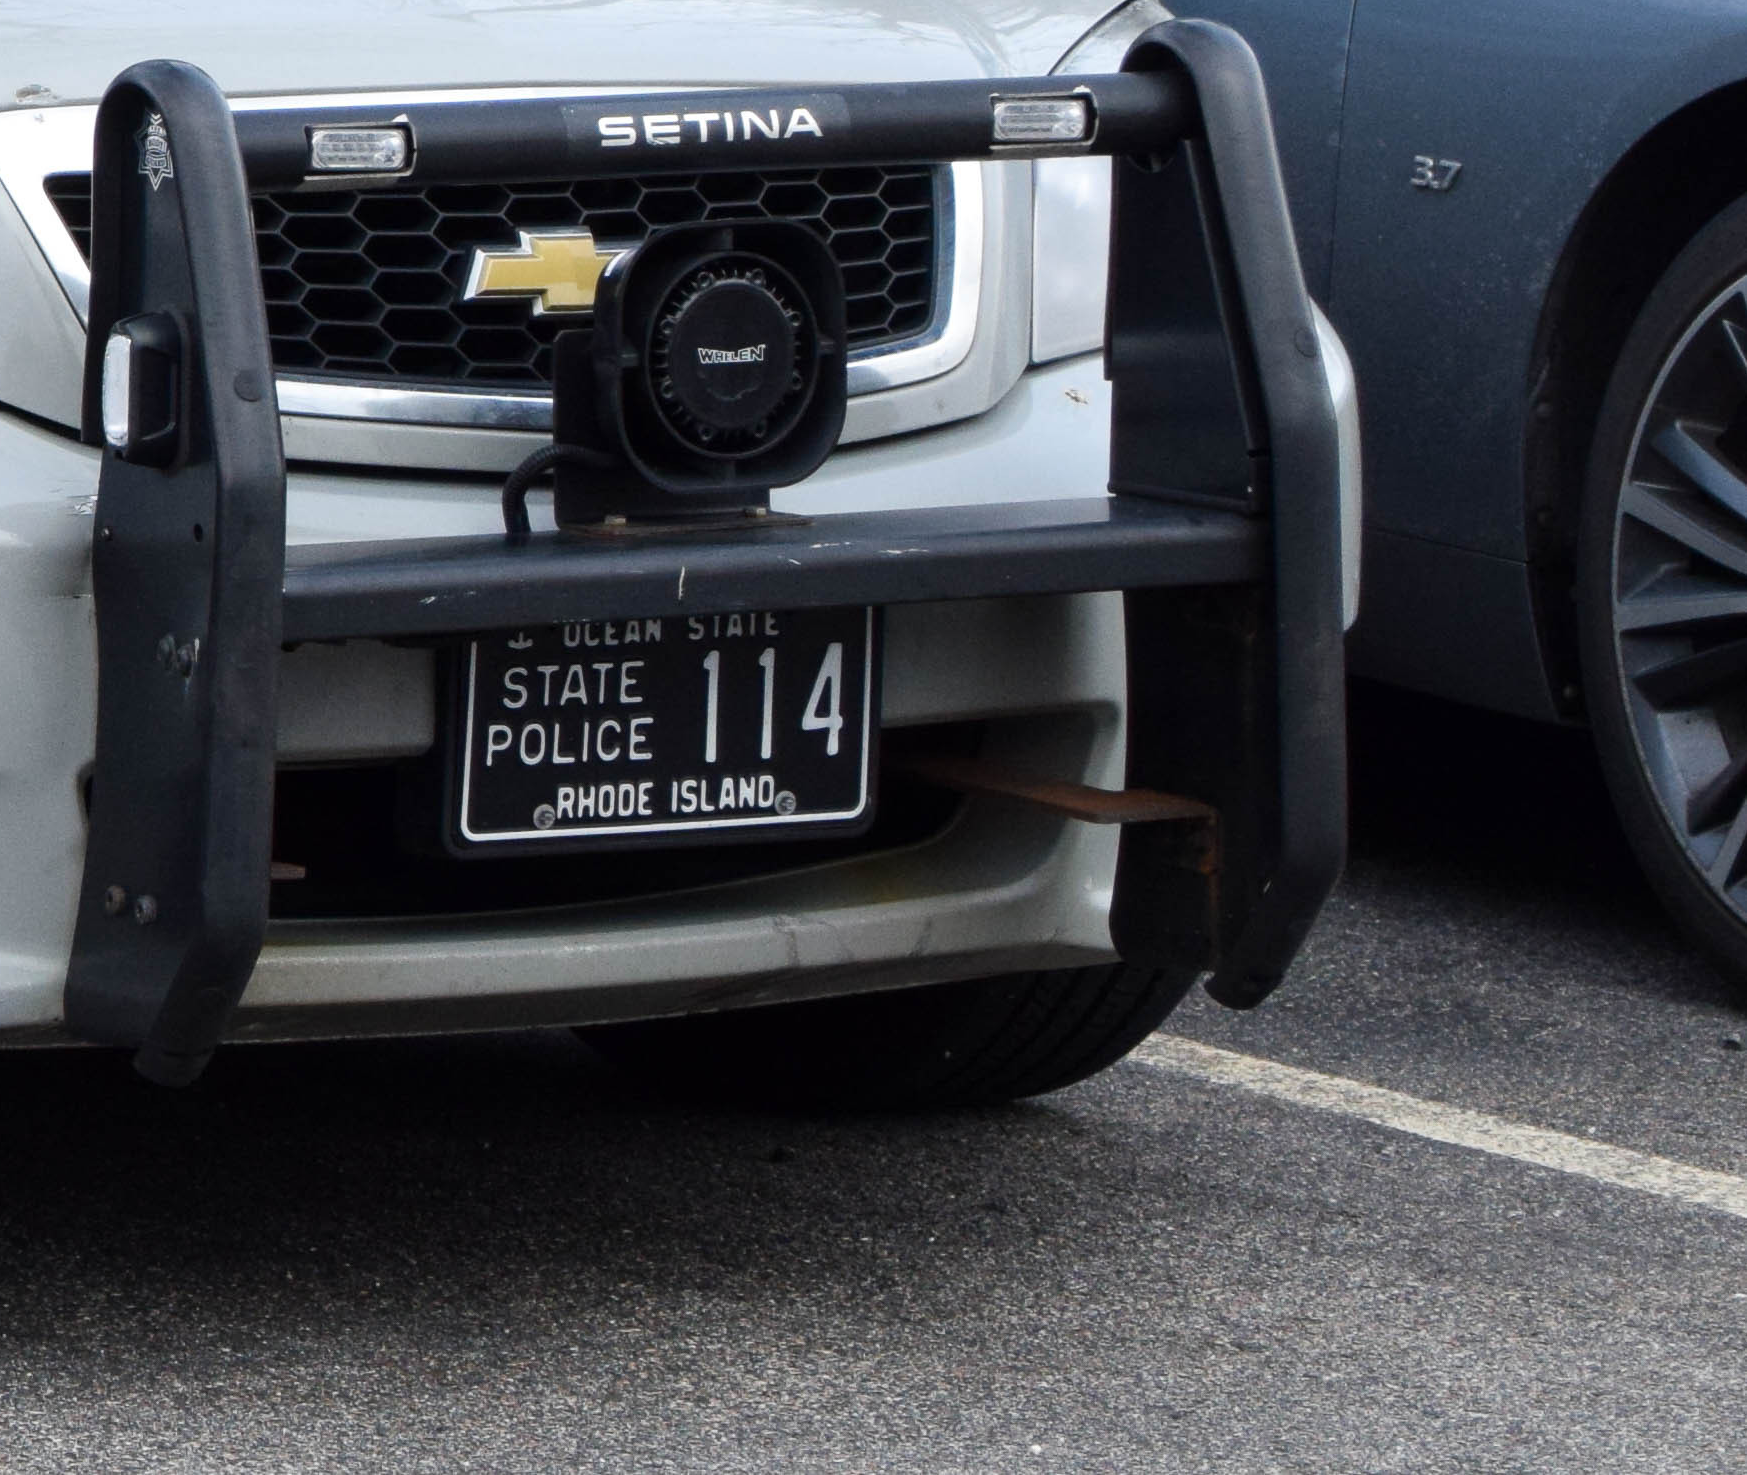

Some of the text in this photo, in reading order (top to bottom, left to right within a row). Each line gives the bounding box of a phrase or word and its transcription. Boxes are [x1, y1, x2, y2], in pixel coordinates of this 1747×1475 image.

[597, 105, 824, 149] SETINA
[697, 344, 767, 365] WHELEN
[563, 611, 780, 648] OCEAN STATE
[502, 660, 646, 709] STATE
[702, 642, 844, 764] 114
[485, 717, 655, 767] POLICE
[556, 774, 775, 820] RHODE ISLAND
